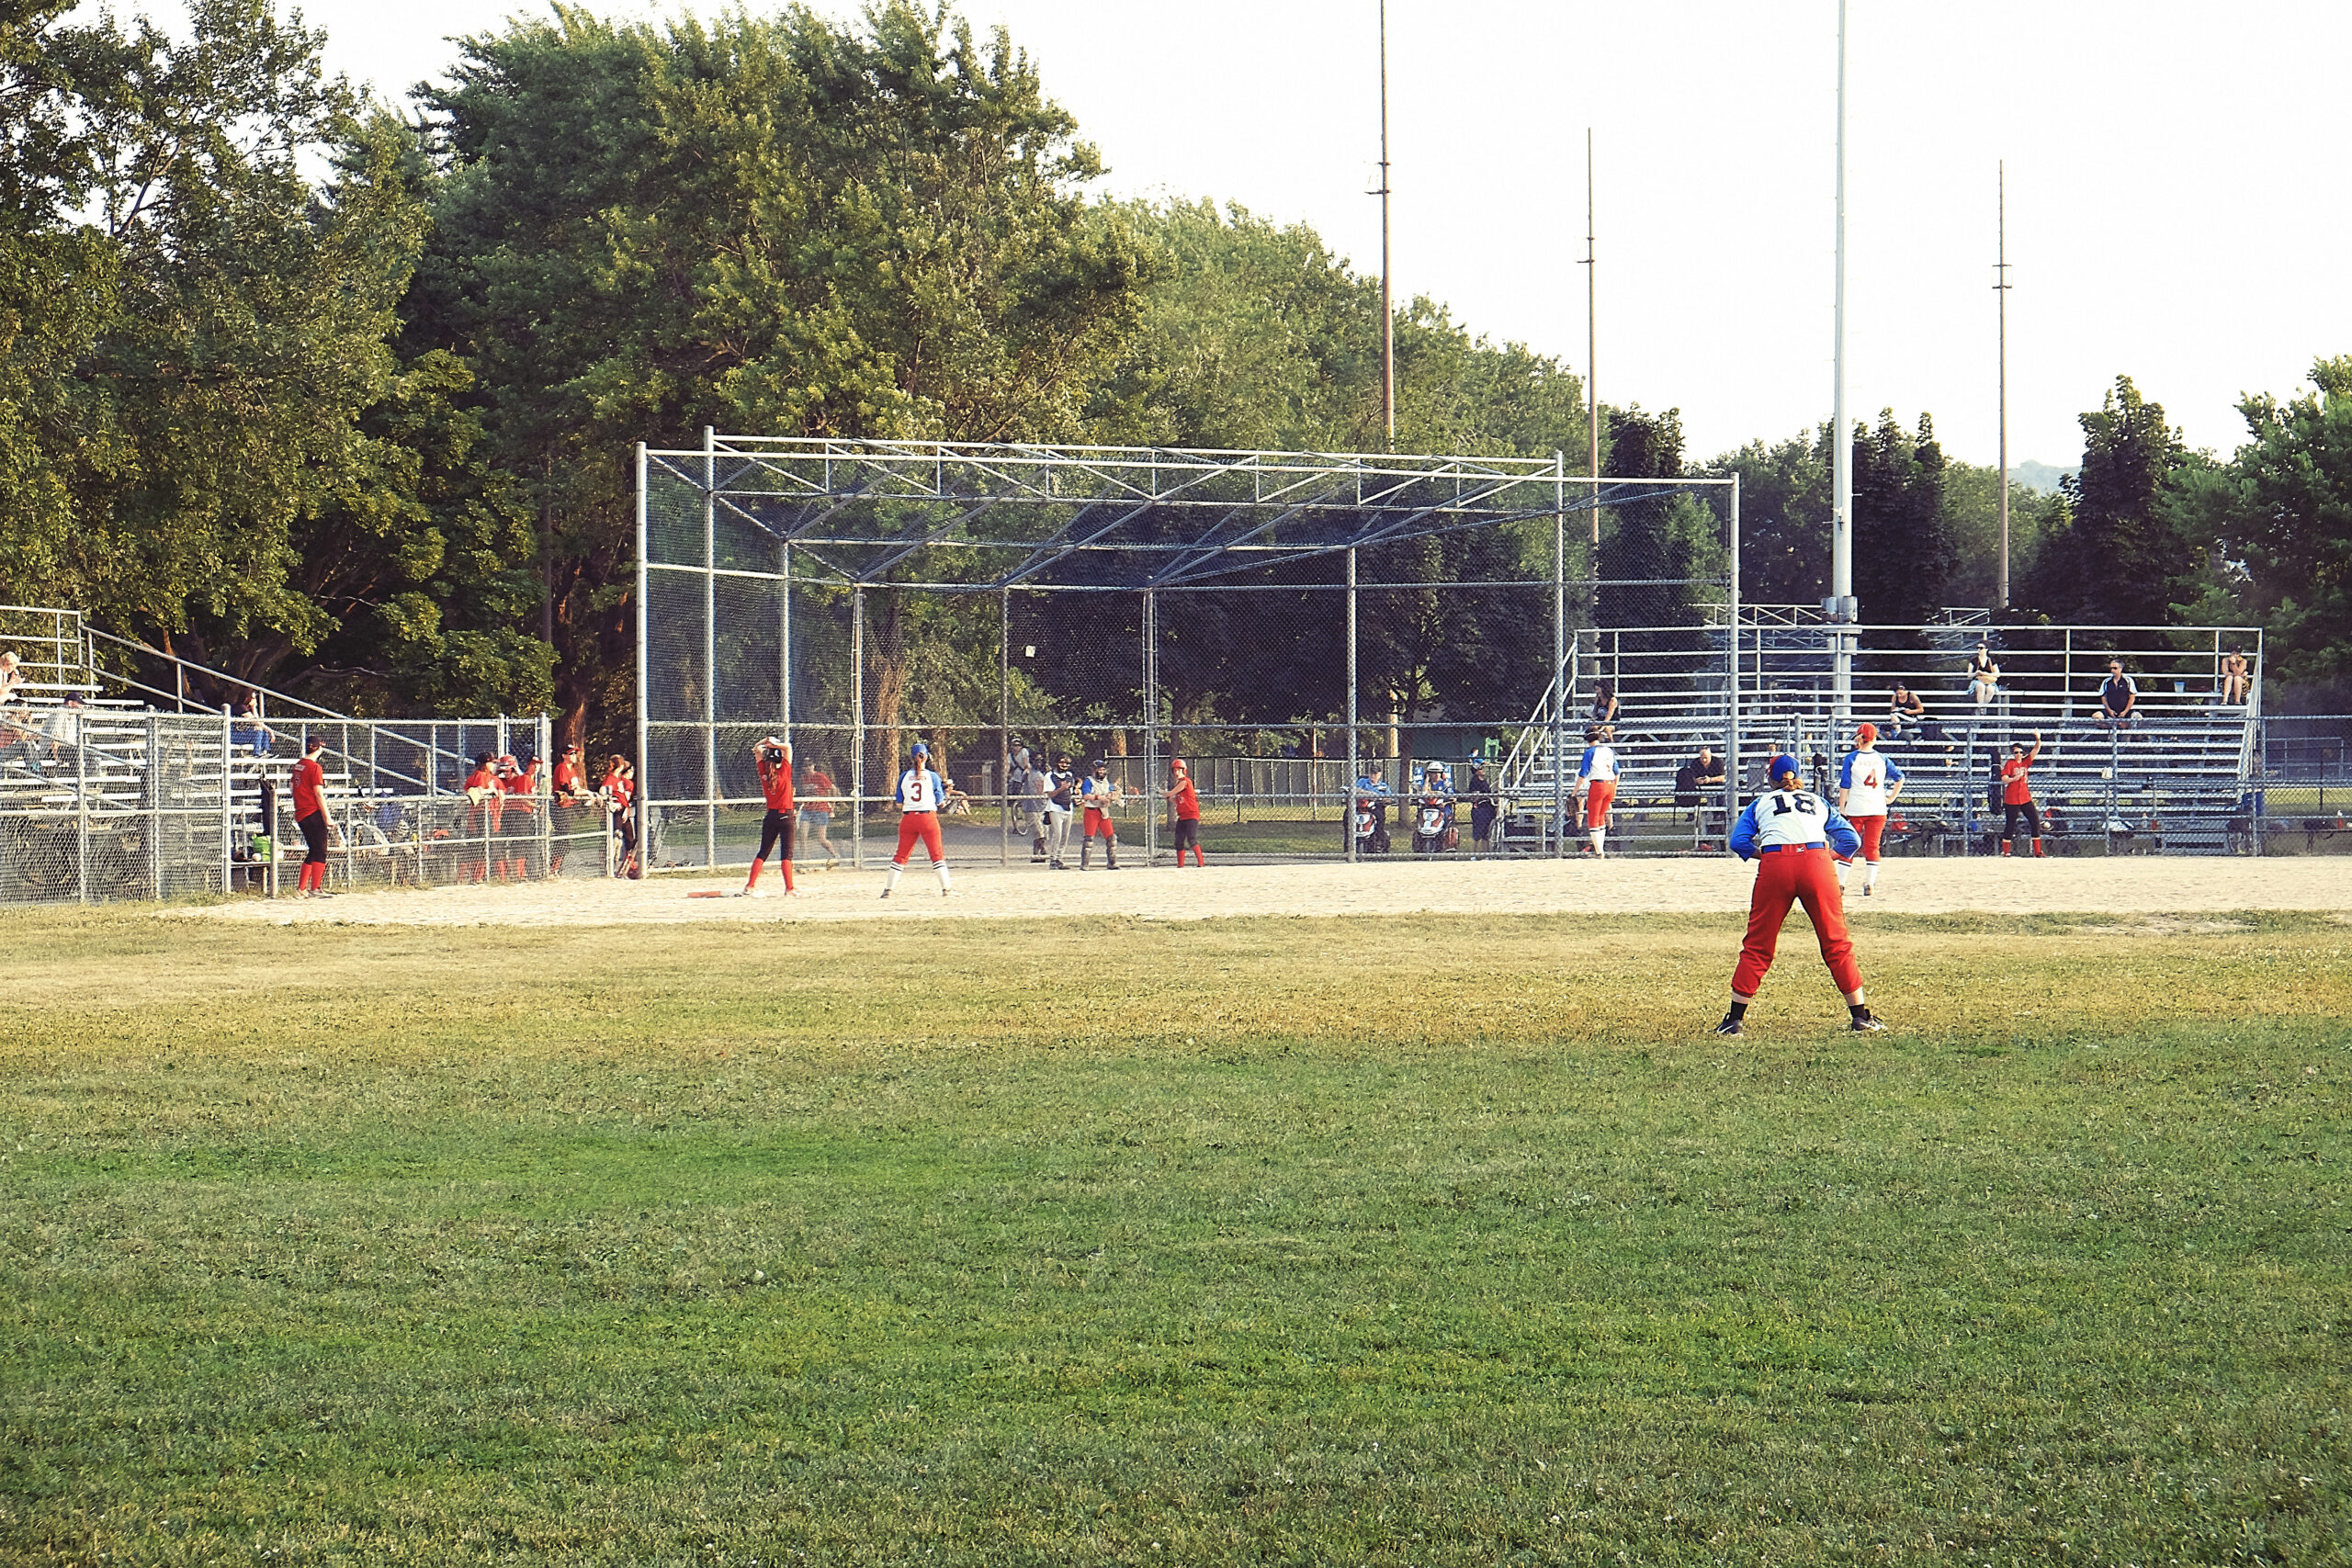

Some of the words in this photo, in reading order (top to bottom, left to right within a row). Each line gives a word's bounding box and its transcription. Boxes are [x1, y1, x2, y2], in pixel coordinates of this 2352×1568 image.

[1863, 768, 1878, 789] 4
[910, 782, 922, 802] 3
[1770, 793, 1815, 816] 18
